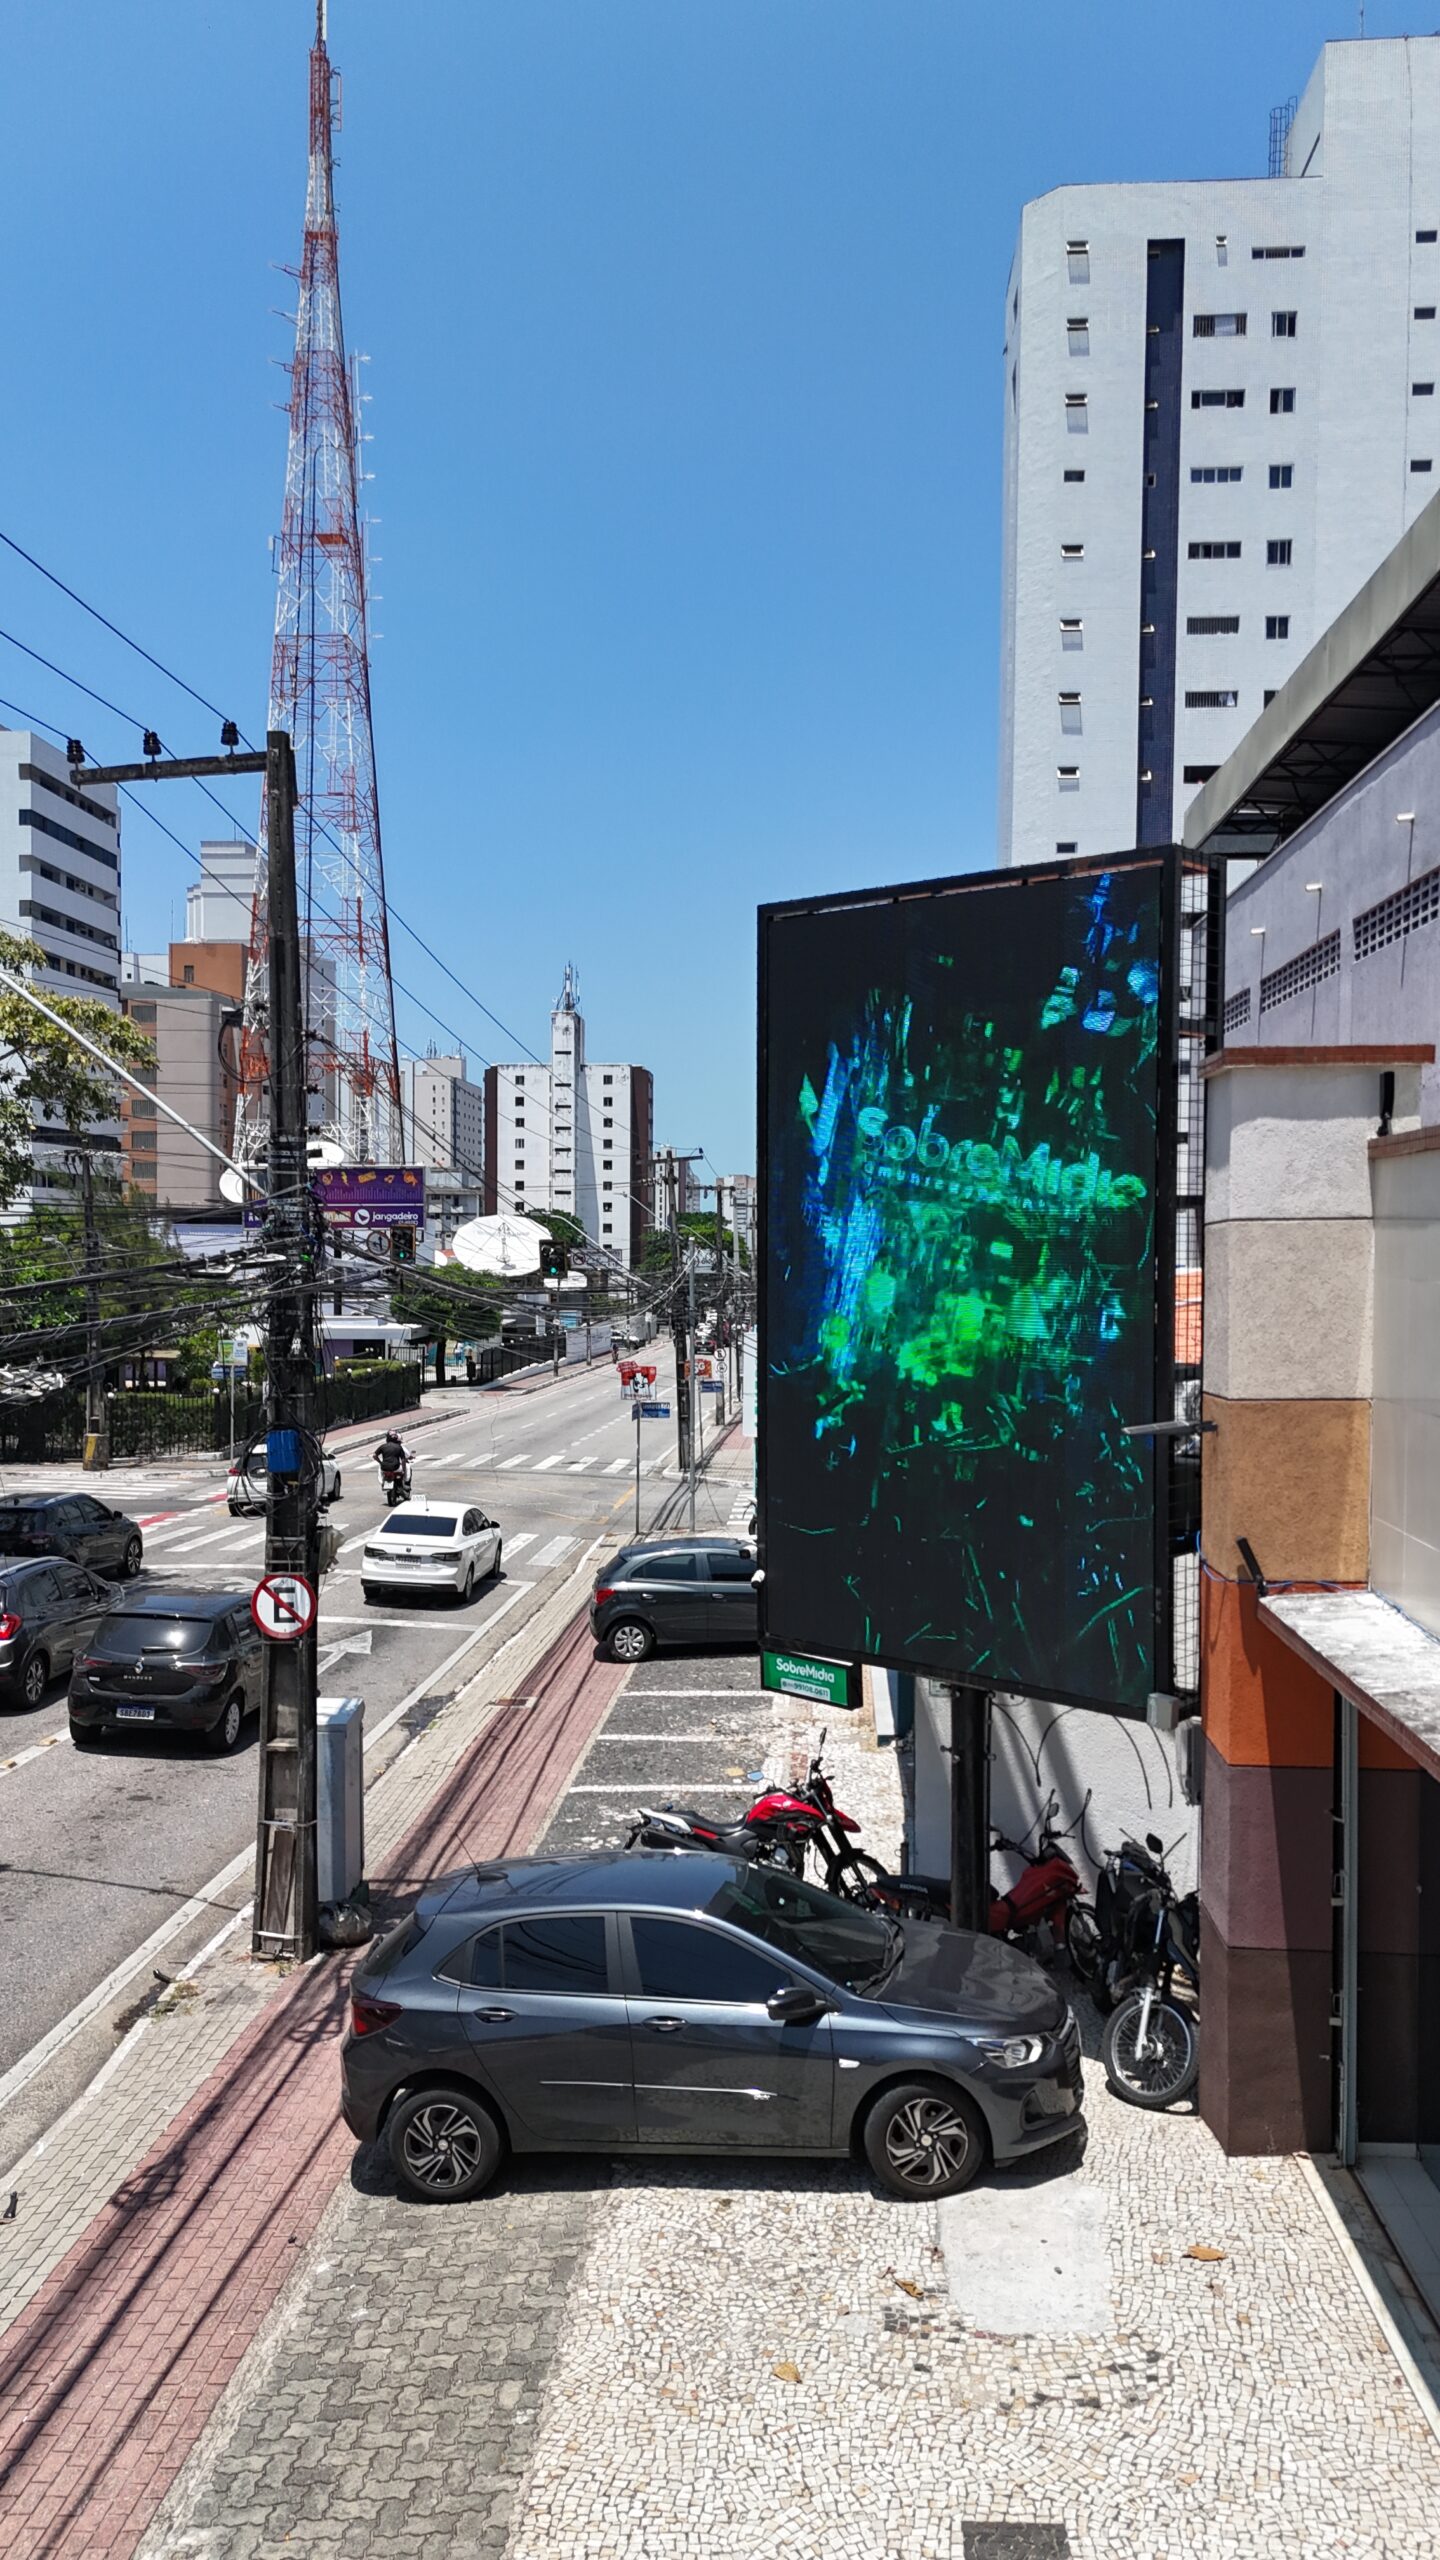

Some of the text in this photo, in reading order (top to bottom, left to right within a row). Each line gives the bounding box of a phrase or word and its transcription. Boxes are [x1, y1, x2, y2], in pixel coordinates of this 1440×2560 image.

[372, 1211, 419, 1223] jangadeiro
[273, 1586, 296, 1624] E
[776, 1657, 835, 1683] SobreMidia
[899, 1883, 928, 1894] HONDA
